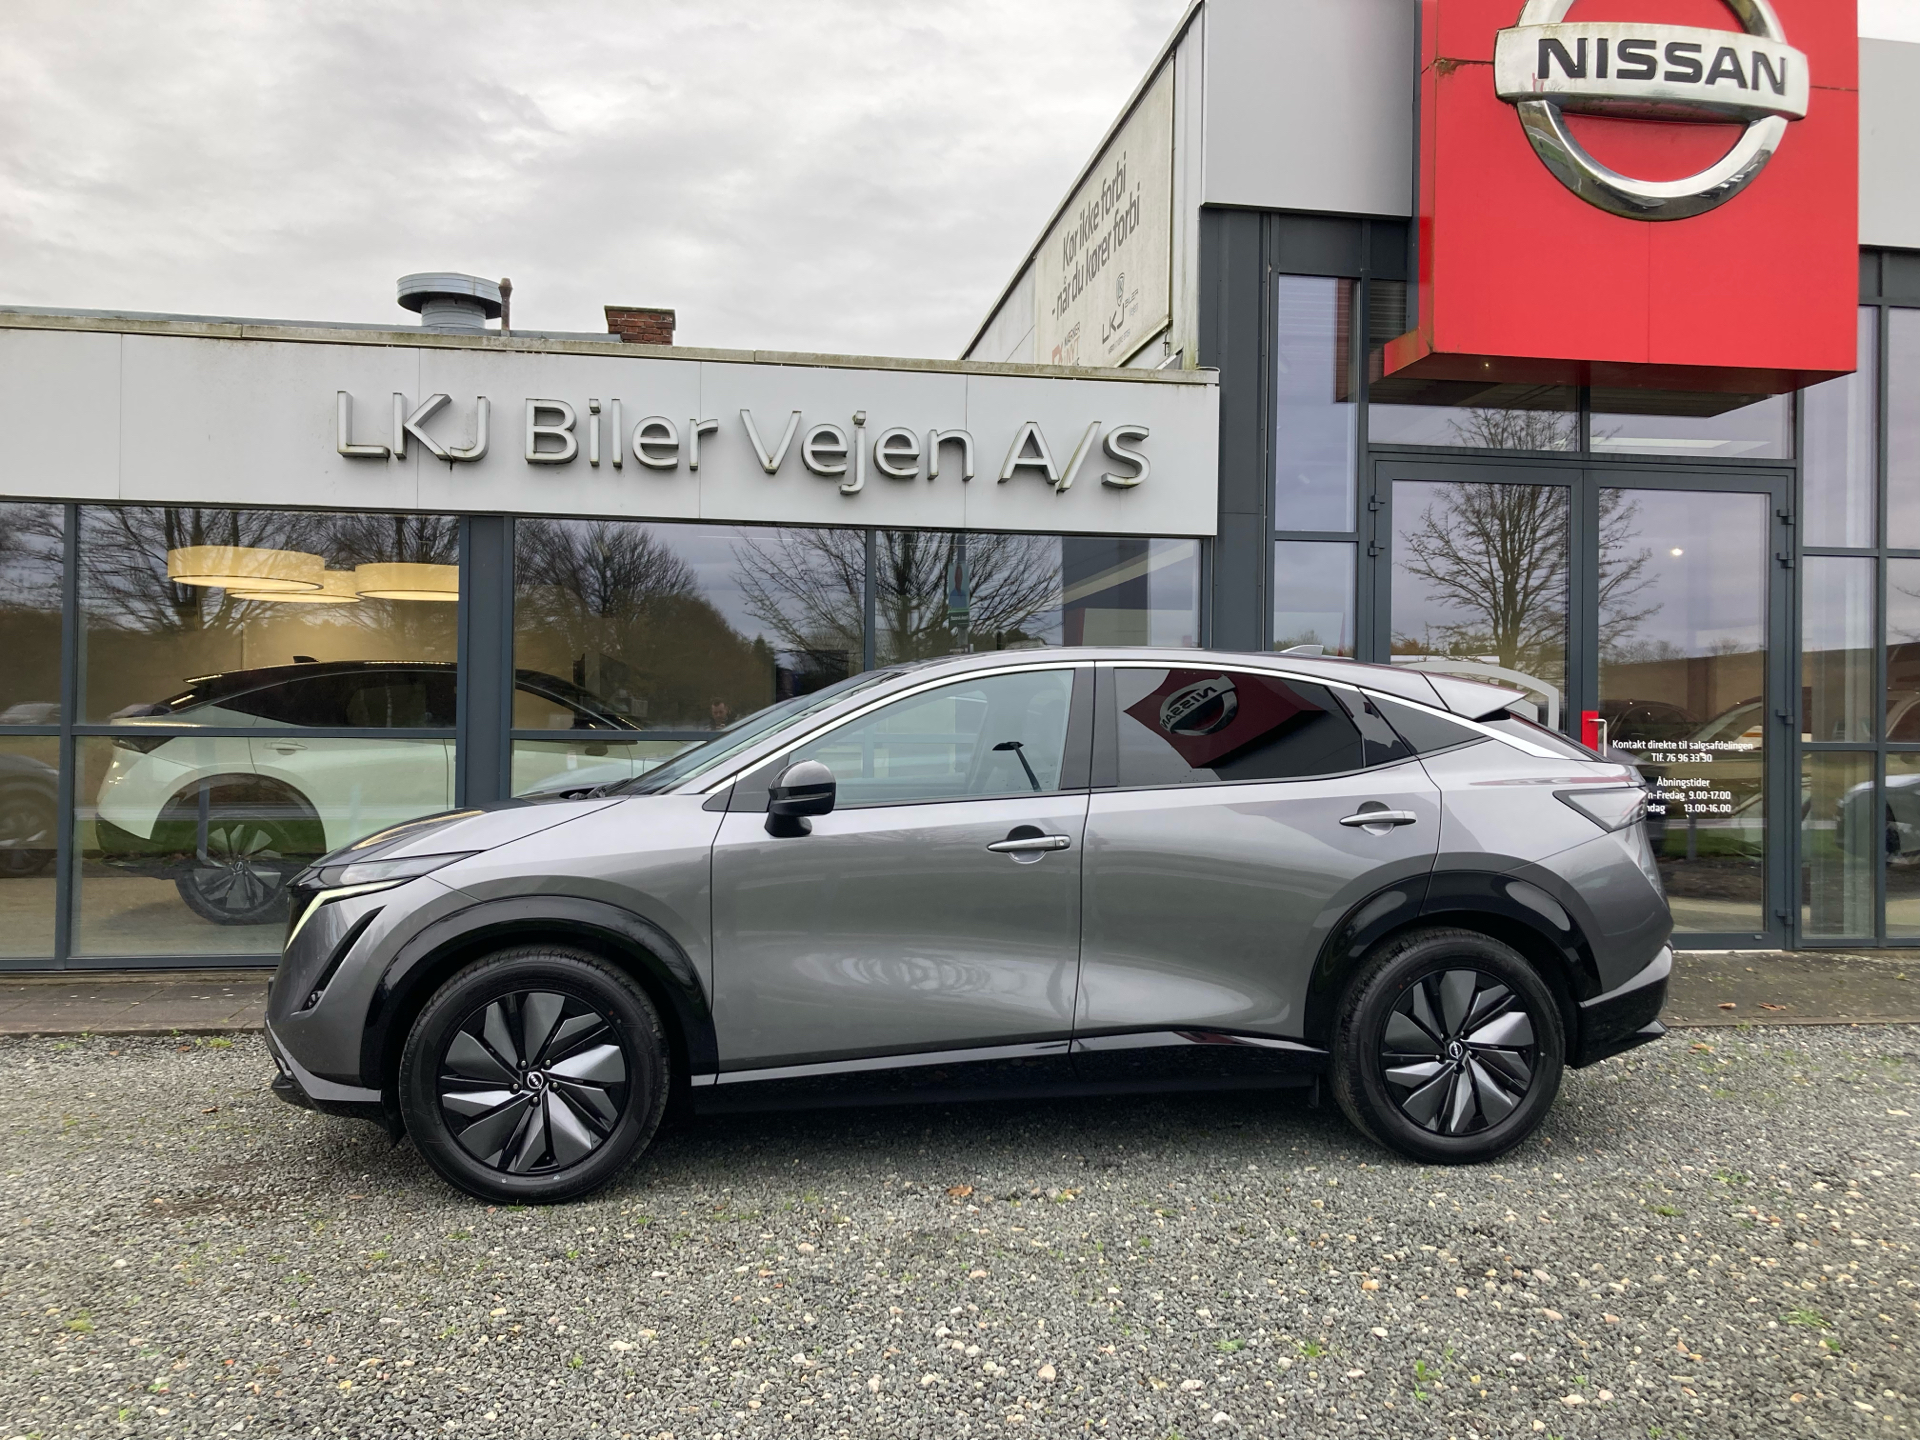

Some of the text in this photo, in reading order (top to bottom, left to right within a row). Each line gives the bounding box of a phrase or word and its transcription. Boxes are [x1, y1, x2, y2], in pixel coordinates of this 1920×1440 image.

[1537, 37, 1787, 96] NISSAN
[1062, 151, 1127, 272] Kør ikke forbi
[1056, 275, 1071, 320] når
[1071, 260, 1084, 303] du
[1086, 232, 1112, 286] kører
[1113, 182, 1140, 253] forbi
[1102, 303, 1125, 344] LKJ
[336, 390, 1150, 495] LKJ Biler Vejen A/S
[1612, 740, 1753, 751] Kontakt direkte til salgsafdelingen
[1651, 753, 1712, 762] Tlf. 76 96 33 30
[1656, 776, 1710, 788] Åbningstider
[1684, 804, 1731, 812] 13.00-16.00
[1689, 791, 1731, 800] 9.00-17.00
